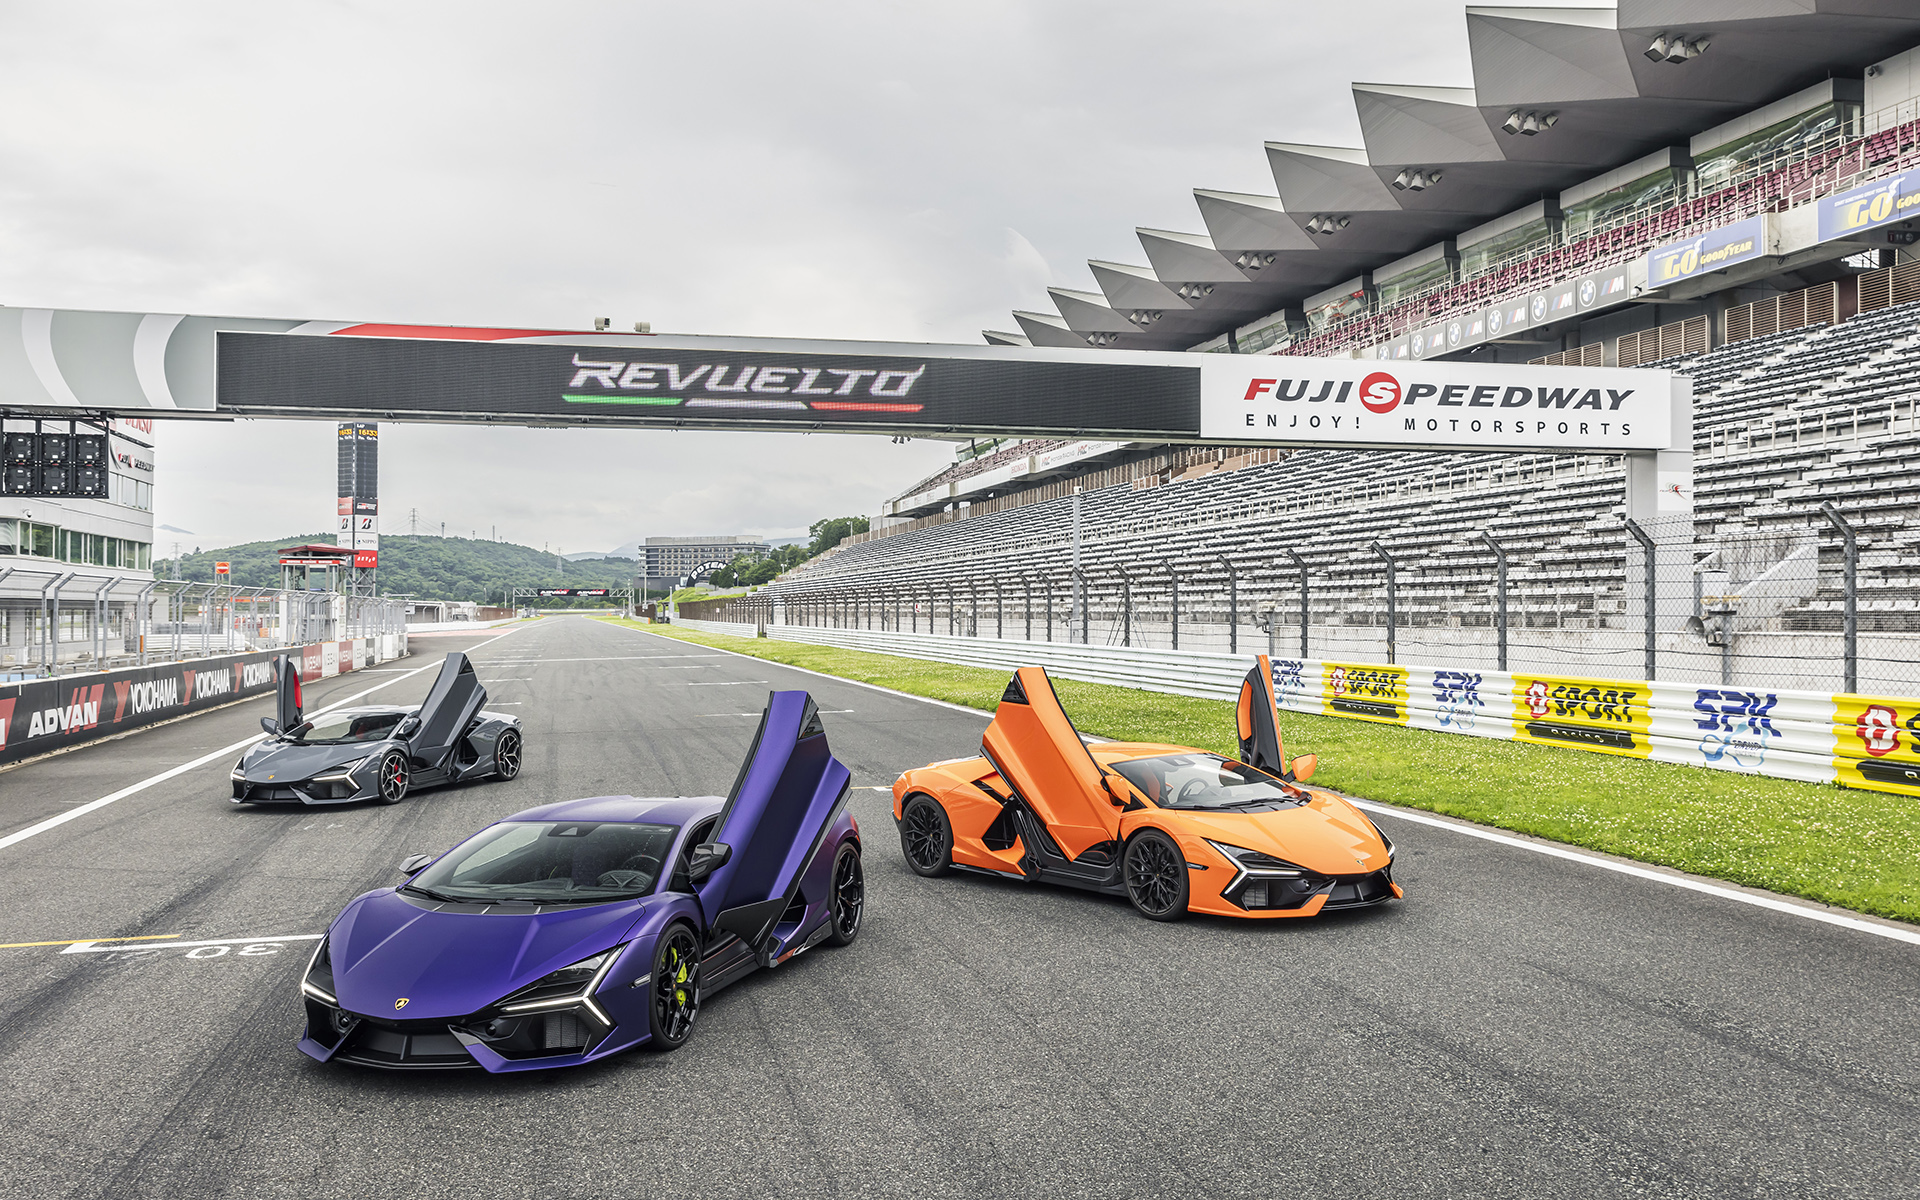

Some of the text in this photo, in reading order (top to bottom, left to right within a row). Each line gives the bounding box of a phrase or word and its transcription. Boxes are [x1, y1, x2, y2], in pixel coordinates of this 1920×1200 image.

[1848, 192, 1893, 228] GO
[1664, 249, 1698, 279] GO
[1700, 241, 1752, 264] GOODYEAR
[568, 353, 925, 397] REVUELTO
[1243, 378, 1353, 404] FUJI
[1245, 413, 1632, 436] ENJOY! MOTORSPORTS
[130, 677, 178, 715] YOKOHAMA
[195, 668, 231, 699] YOKOHAMA
[1347, 670, 1400, 698] SPORT
[27, 701, 98, 738] ADVAN
[1551, 686, 1637, 723] SPORT
